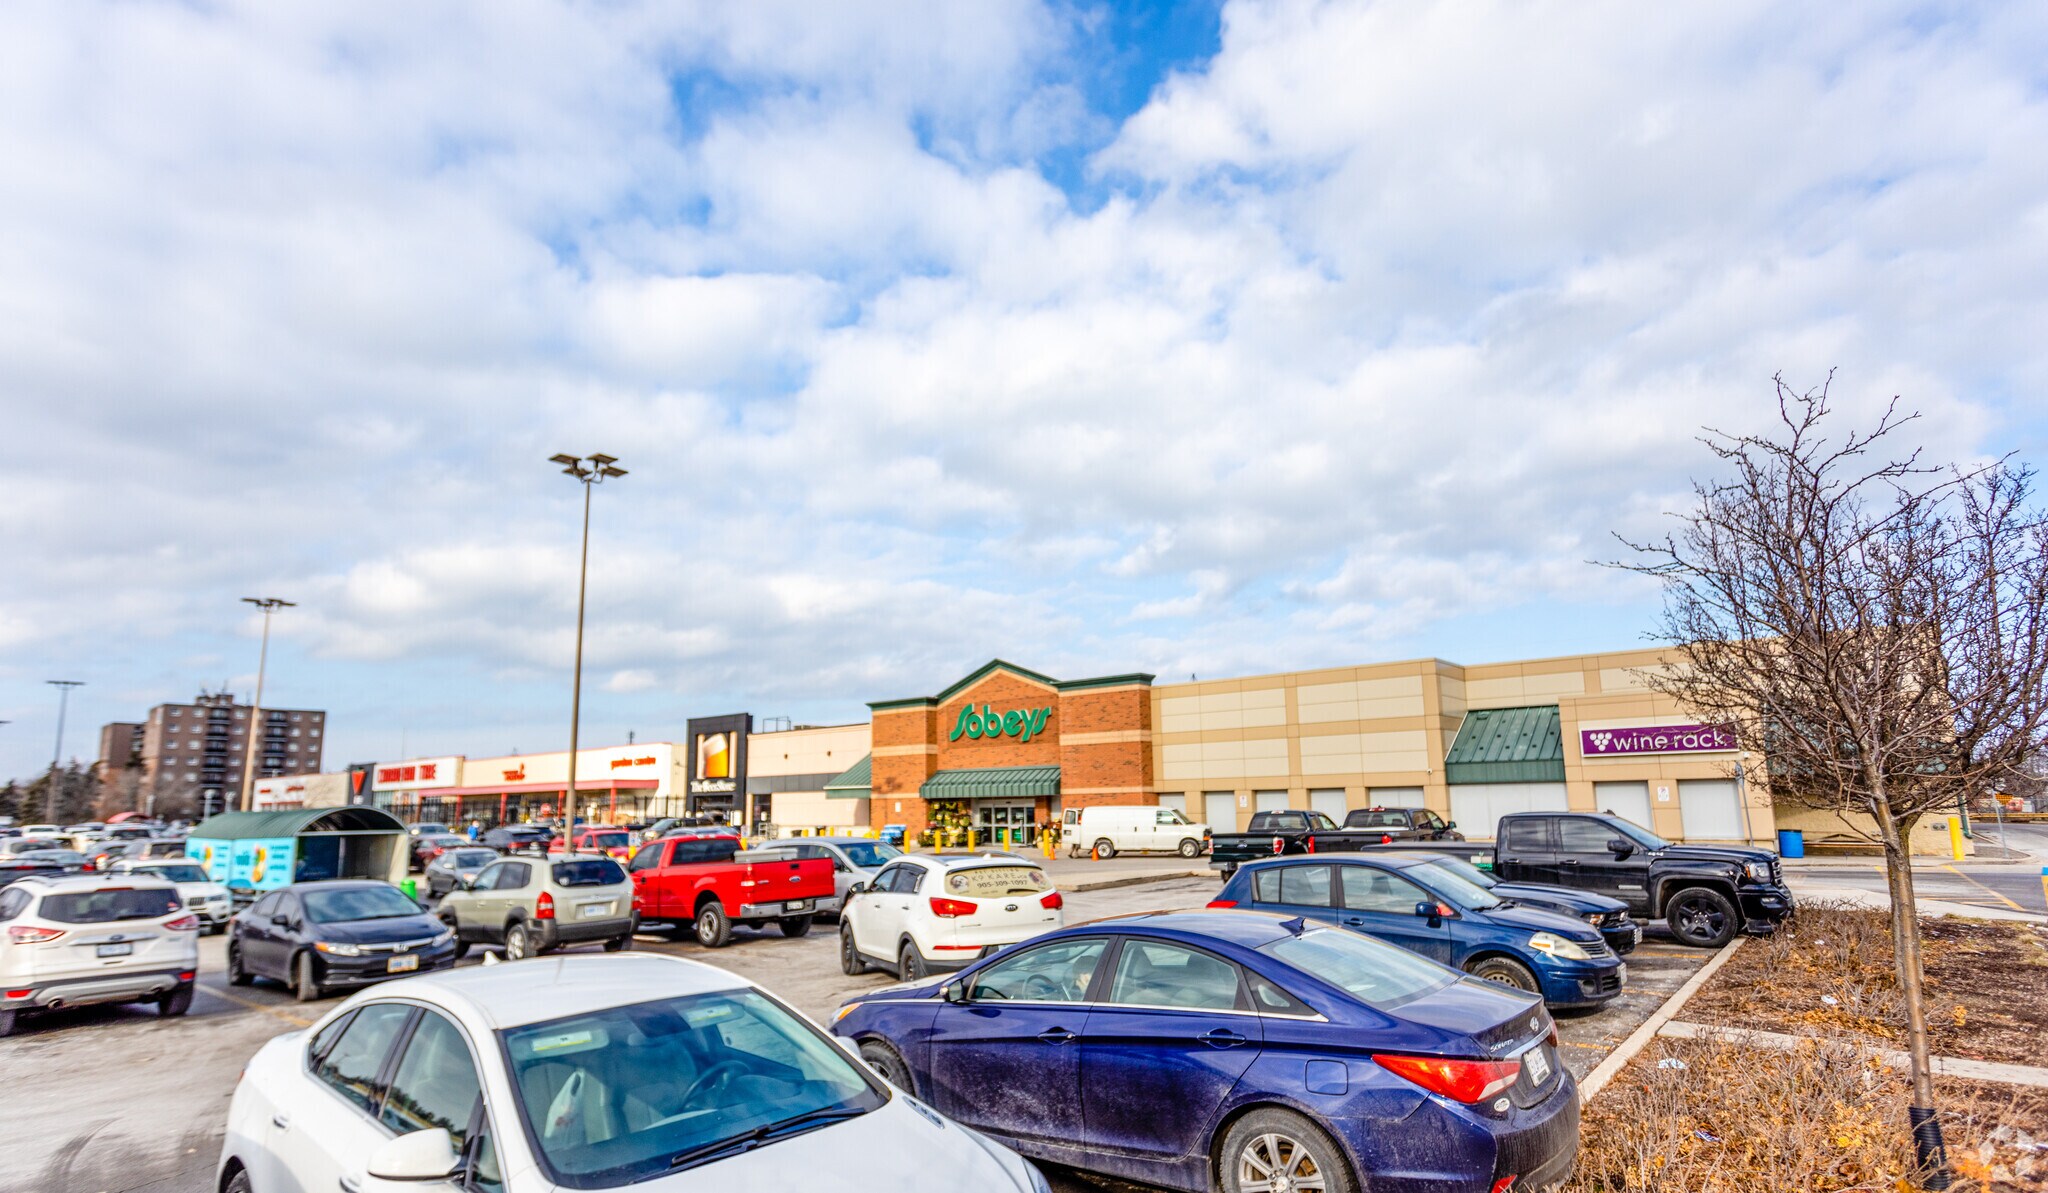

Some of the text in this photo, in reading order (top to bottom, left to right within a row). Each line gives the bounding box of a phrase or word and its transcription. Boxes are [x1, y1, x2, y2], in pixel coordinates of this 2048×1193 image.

[950, 703, 1052, 742] Sobeys
[1613, 728, 1728, 751] wine rack
